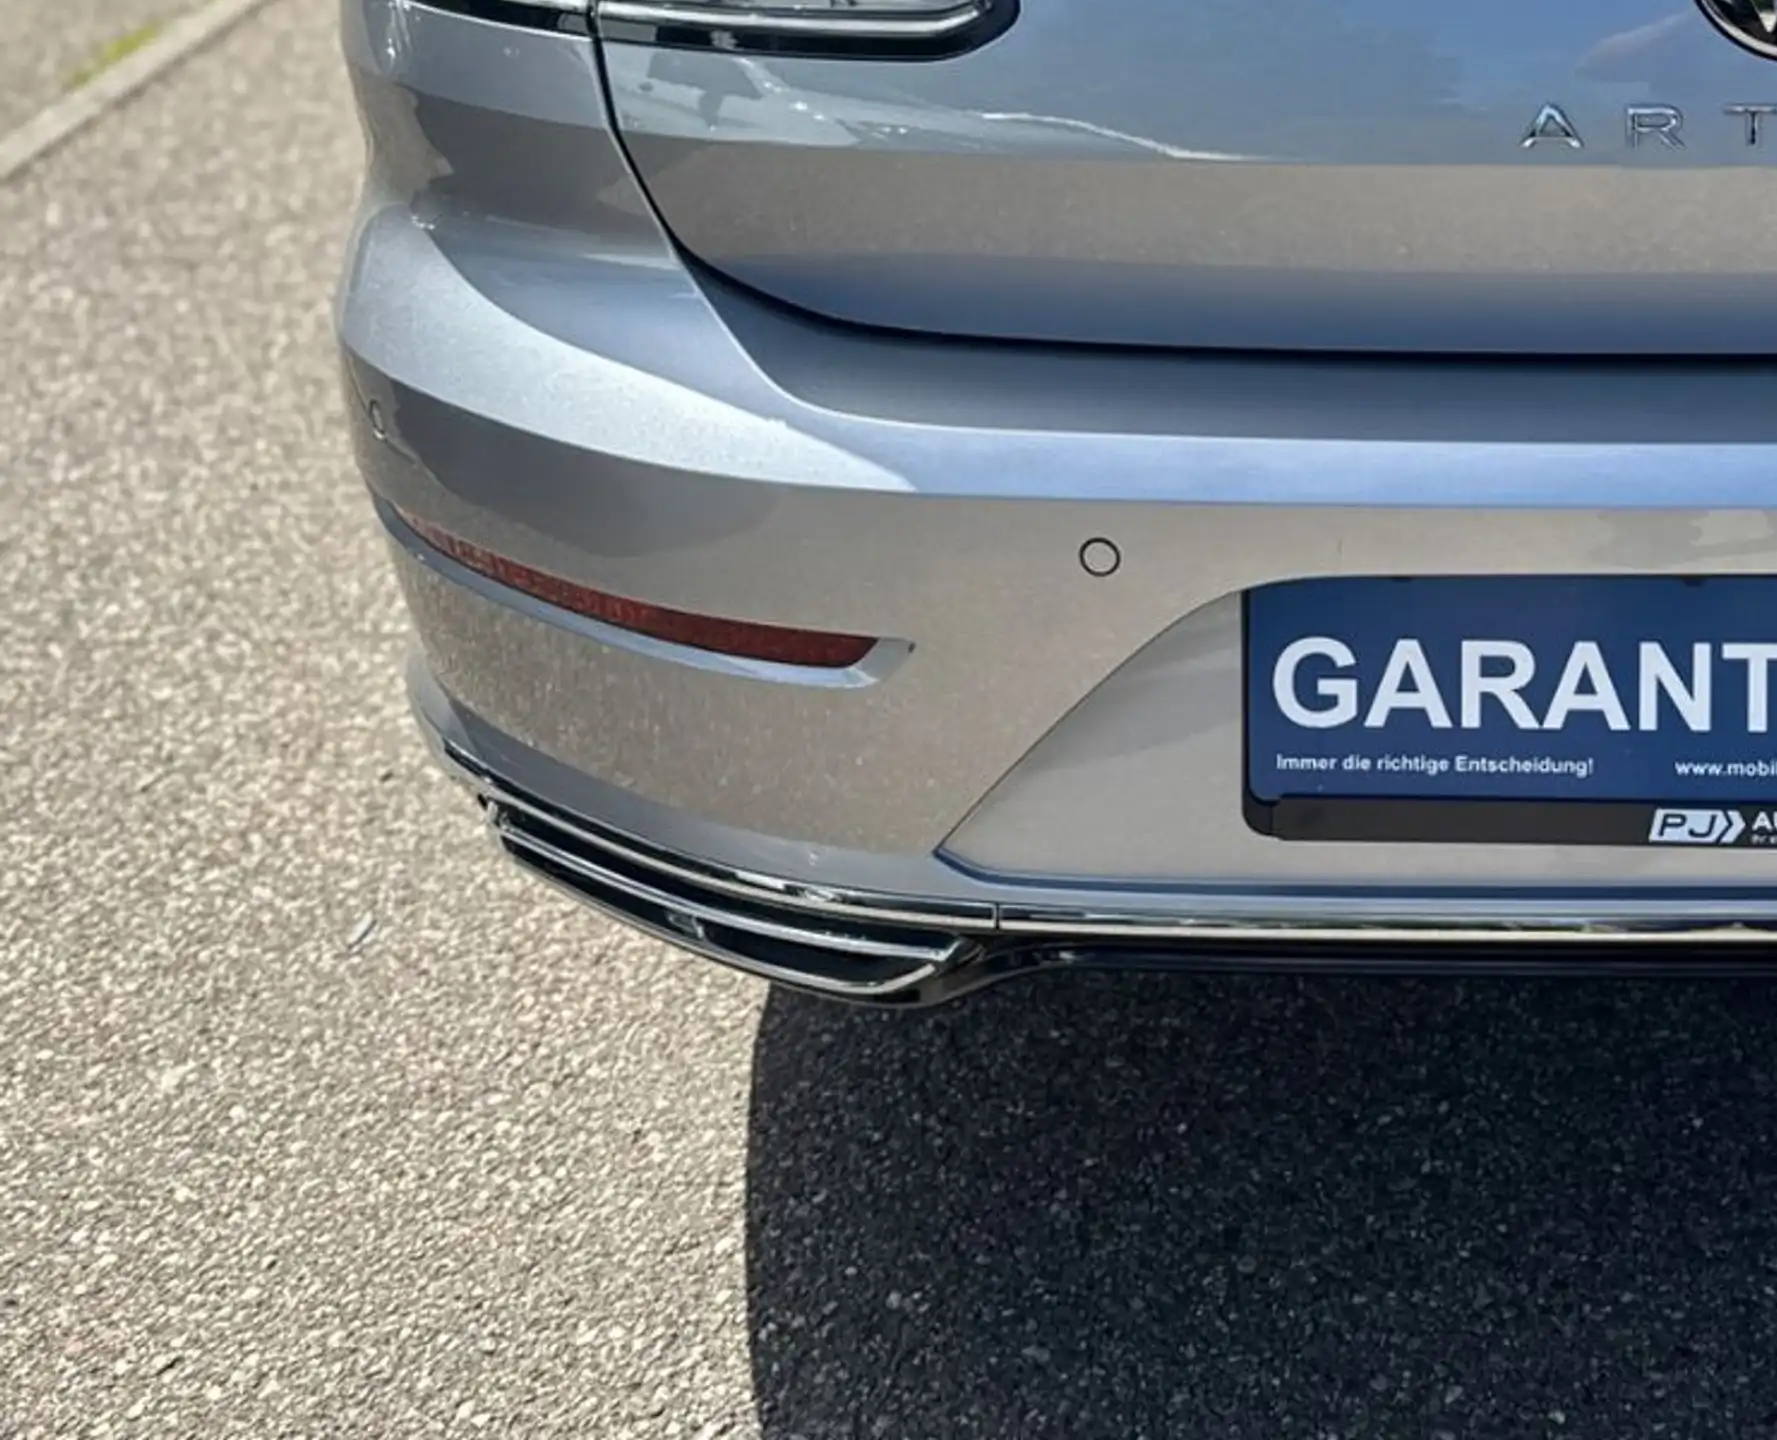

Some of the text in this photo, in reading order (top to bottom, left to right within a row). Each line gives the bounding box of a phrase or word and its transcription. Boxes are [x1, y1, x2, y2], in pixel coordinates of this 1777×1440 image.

[1276, 753, 1595, 778] Immer die richtige Entscheidung!
[1658, 813, 1717, 838] PJ
